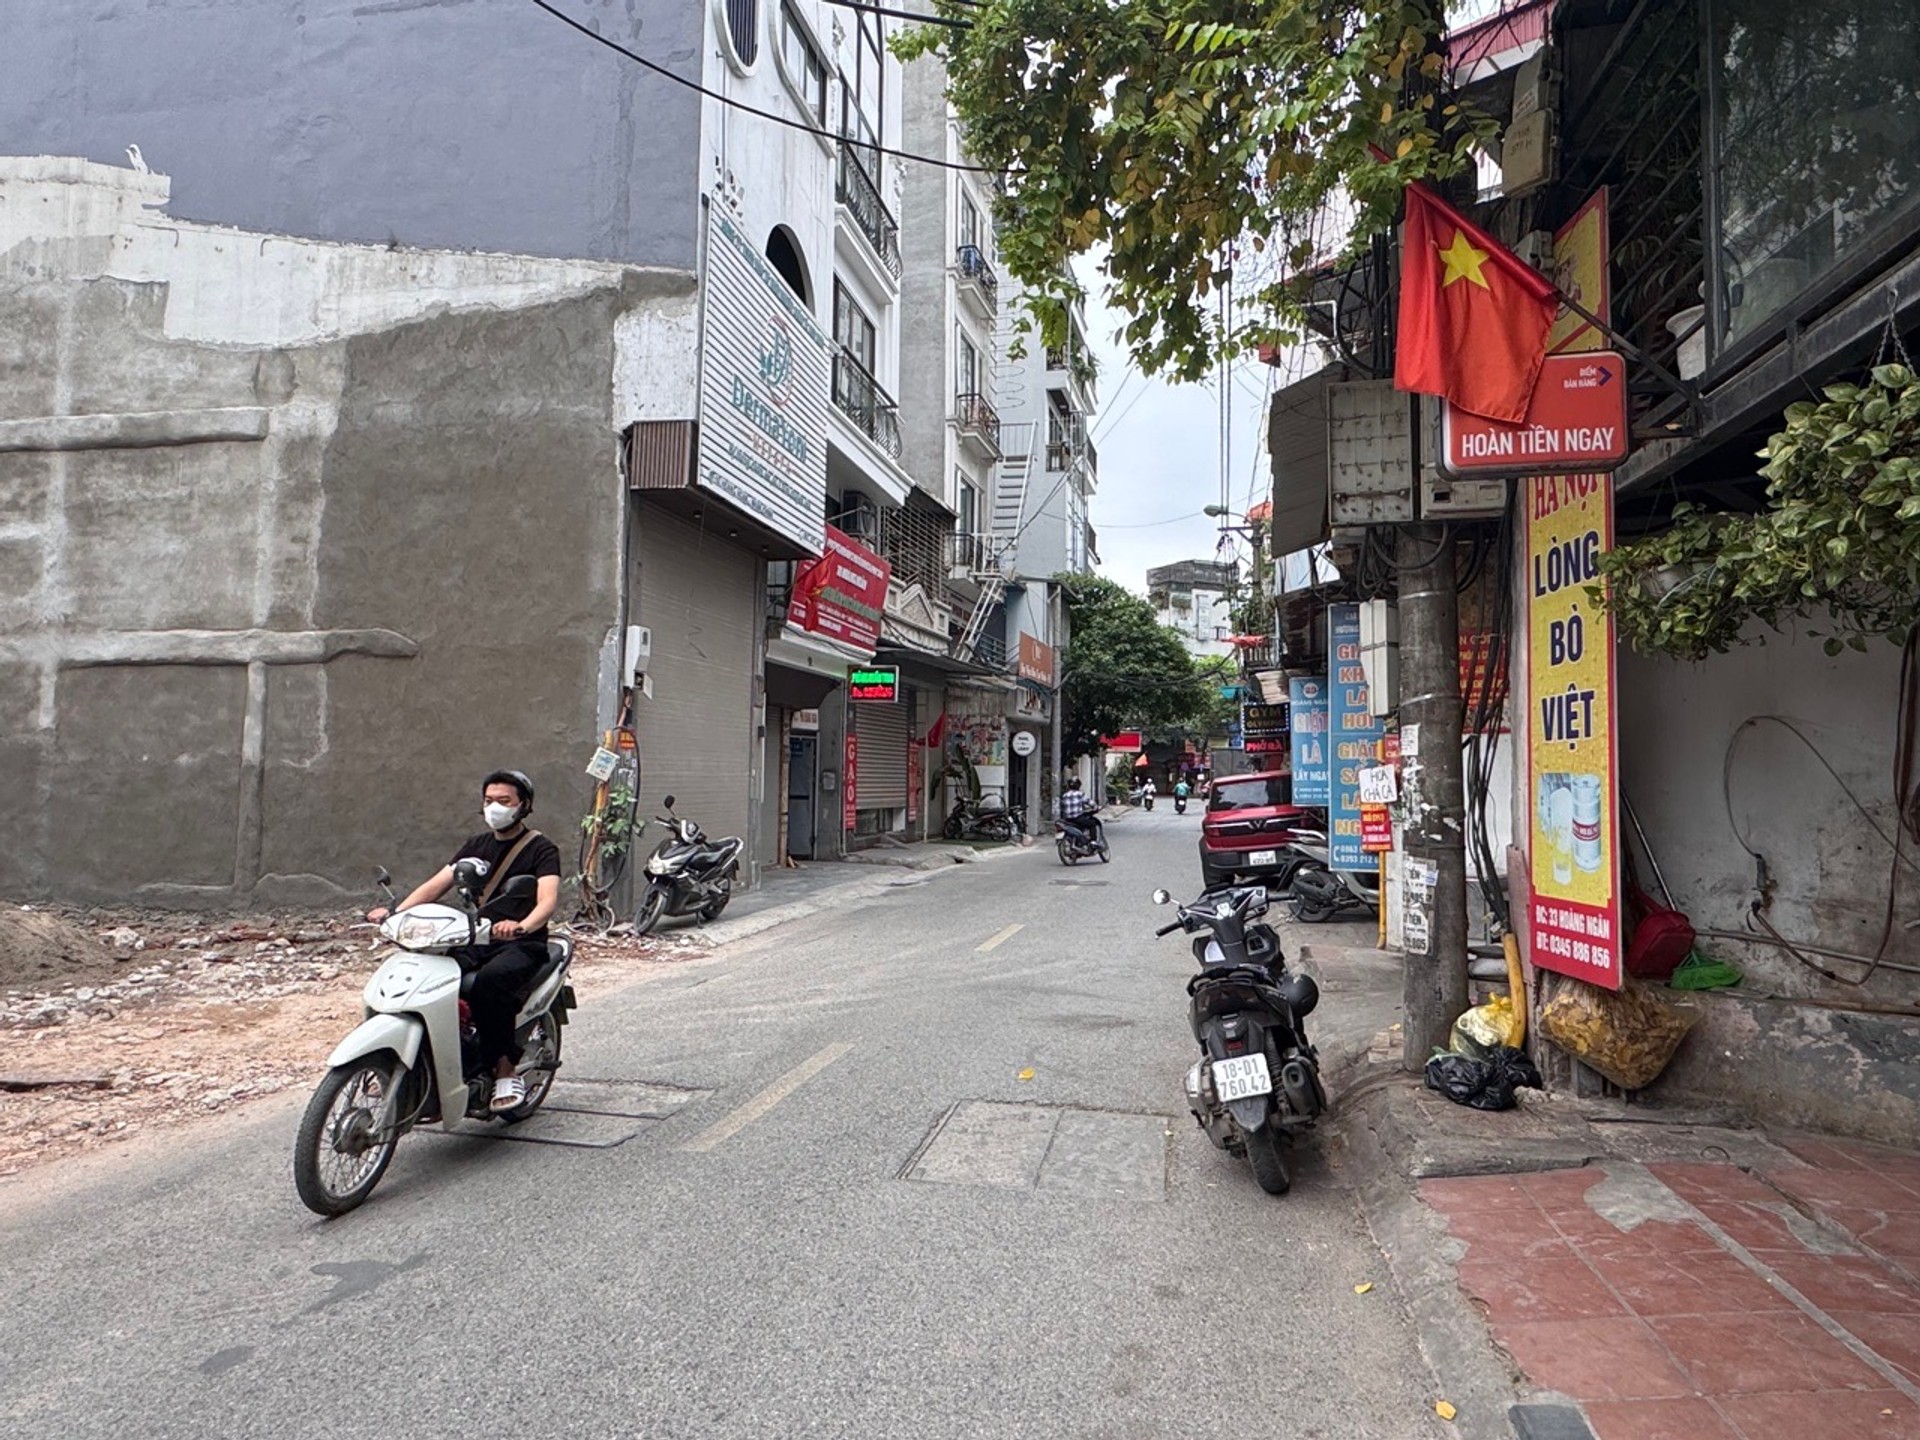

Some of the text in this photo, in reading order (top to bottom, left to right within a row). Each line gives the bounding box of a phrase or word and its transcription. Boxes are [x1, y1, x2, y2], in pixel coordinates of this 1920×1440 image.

[1462, 424, 1615, 458] HOÀN TIỀN NGAY
[1534, 529, 1600, 598] LÒNG
[1550, 603, 1584, 666] BÒ
[1541, 683, 1595, 750] VIỆT
[1220, 1074, 1268, 1098] 760.42
